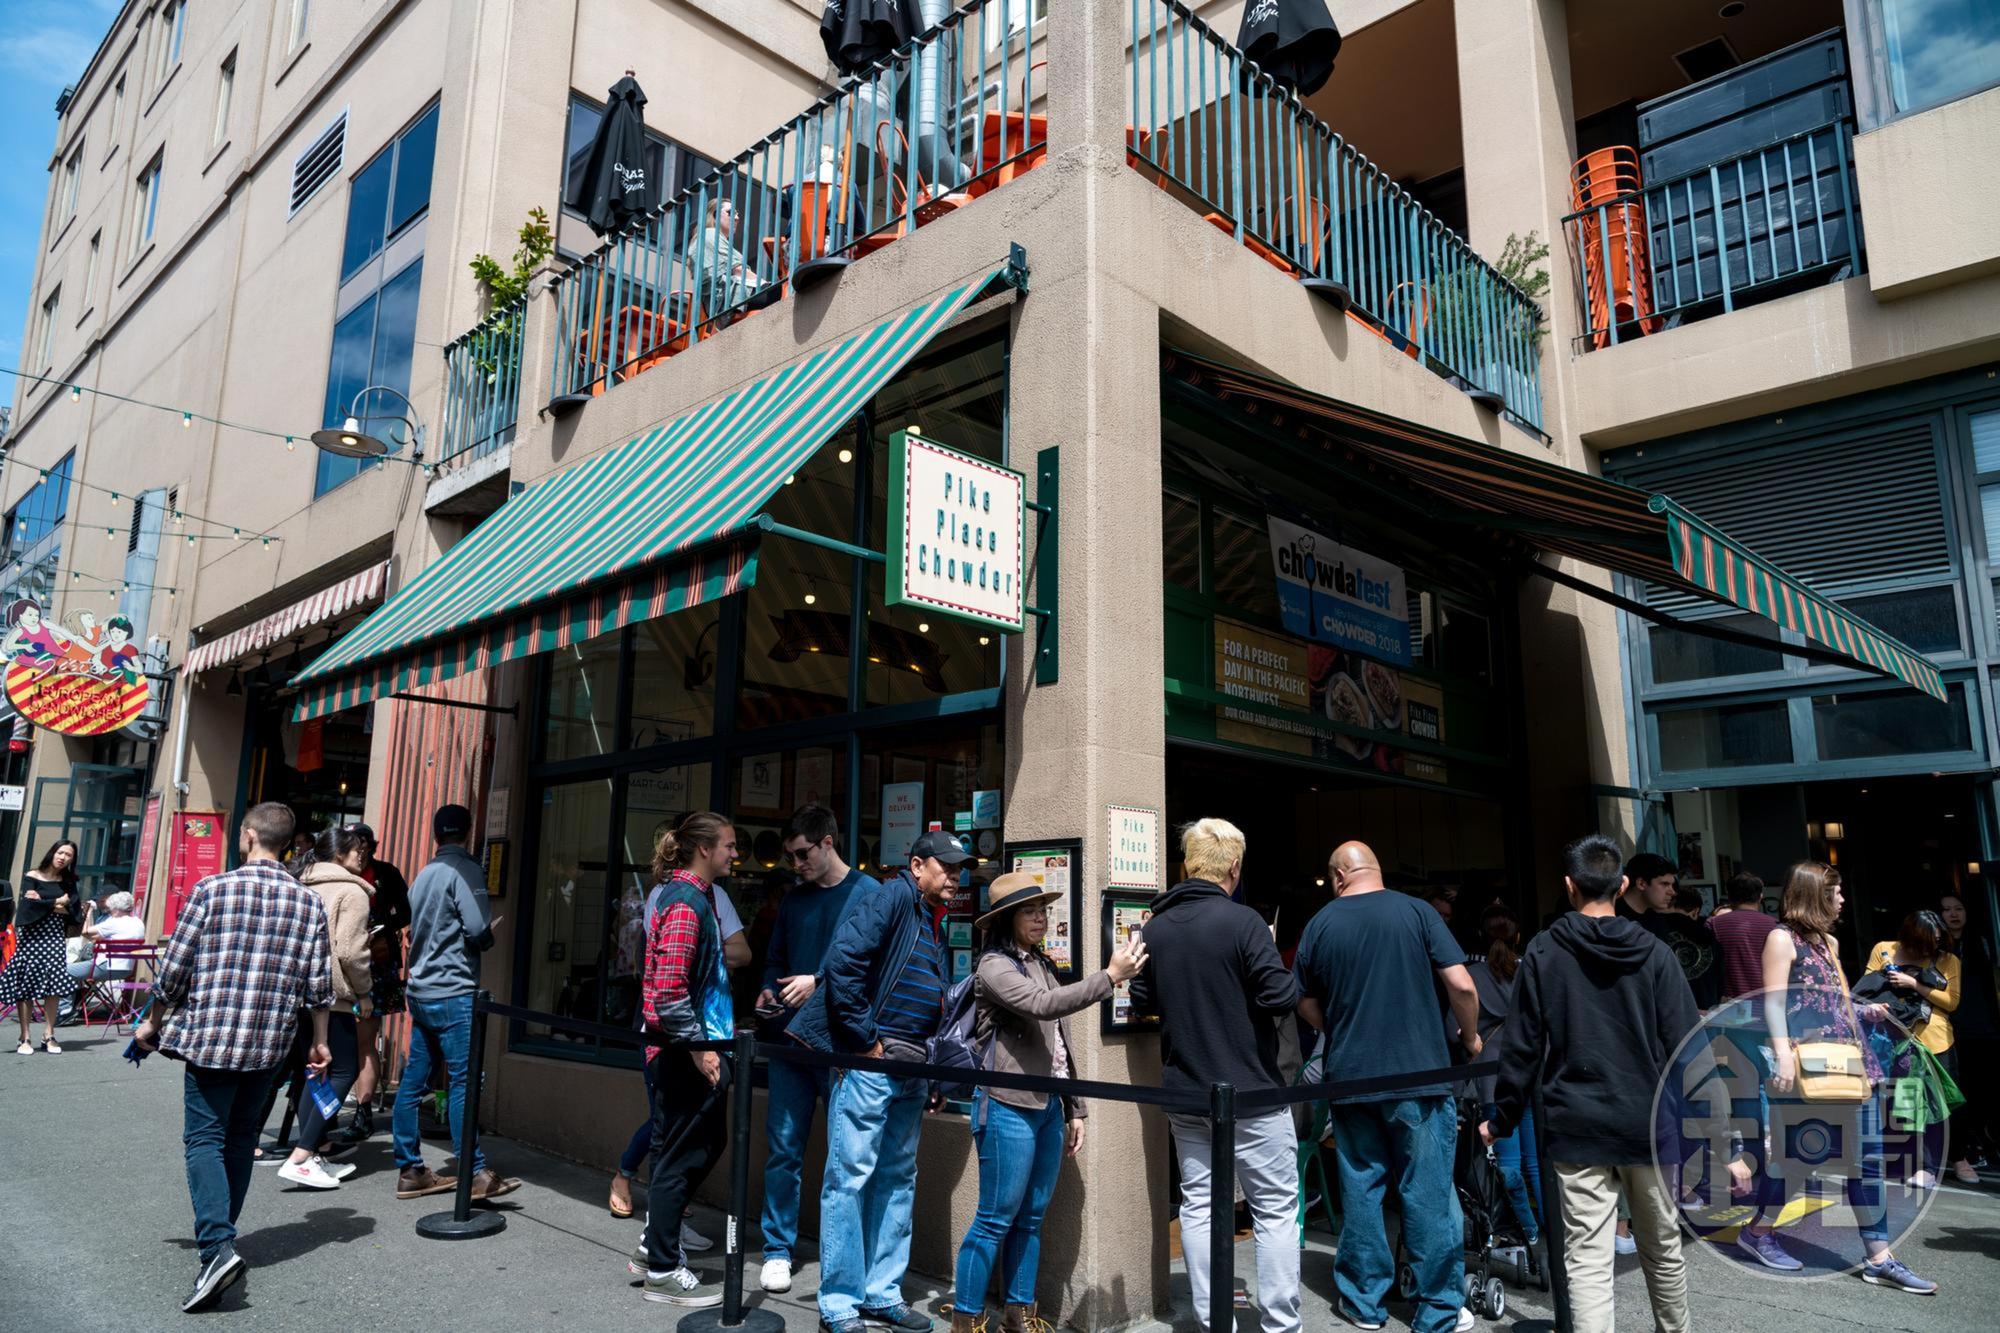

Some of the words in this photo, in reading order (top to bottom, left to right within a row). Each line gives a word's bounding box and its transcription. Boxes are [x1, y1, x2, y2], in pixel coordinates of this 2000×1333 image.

[944, 472, 990, 512] Pike
[937, 508, 997, 553] Place
[919, 543, 1012, 595] Chowder
[1278, 541, 1391, 610] chowdafest
[1322, 615, 1377, 647] CHOWDER
[1378, 635, 1402, 655] 2018
[1223, 639, 1243, 658] FOR
[1244, 645, 1250, 662] A
[1252, 647, 1289, 672] PERFECT
[1224, 660, 1244, 678] DAY
[1244, 665, 1254, 682] IN
[1256, 668, 1272, 688] THE
[1273, 674, 1306, 697] PACIFIC
[41, 683, 121, 706] EUROPEAN
[28, 699, 123, 722] SANDWICHES
[1410, 718, 1437, 741] CHOWDER
[888, 803, 916, 813] DELIVER
[896, 794, 908, 803] WE
[1123, 817, 1145, 834] Pike
[1120, 837, 1148, 854] Place
[1114, 856, 1154, 873] Chowder
